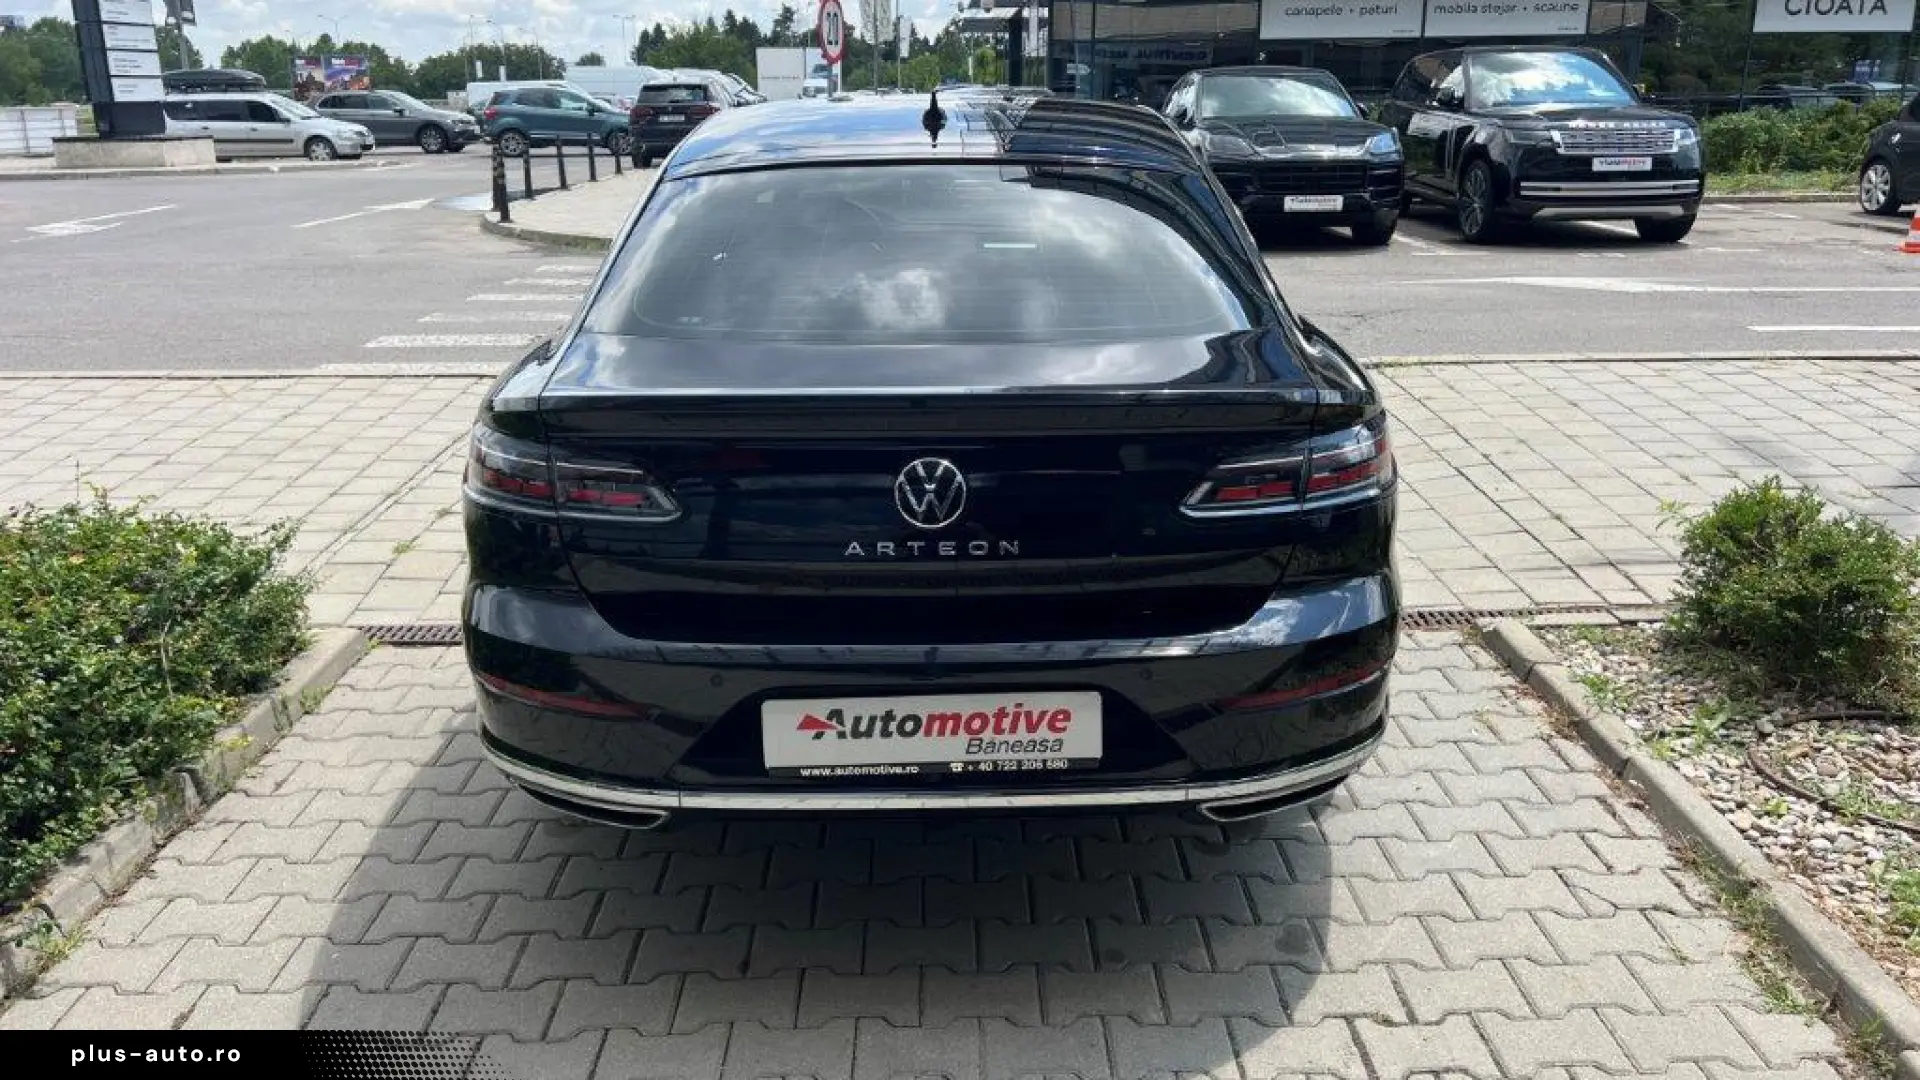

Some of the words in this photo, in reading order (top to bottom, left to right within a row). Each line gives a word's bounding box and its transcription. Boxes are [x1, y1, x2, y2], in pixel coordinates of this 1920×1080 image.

[1284, 3, 1344, 18] canapele
[1433, 2, 1478, 14] mobila
[1481, 2, 1518, 15] stejar
[1533, 2, 1580, 13] scaune
[844, 540, 1020, 556] ARTEON
[797, 702, 1072, 741] Automotive
[800, 764, 920, 777] www.automotive.ro
[979, 760, 993, 772] 40
